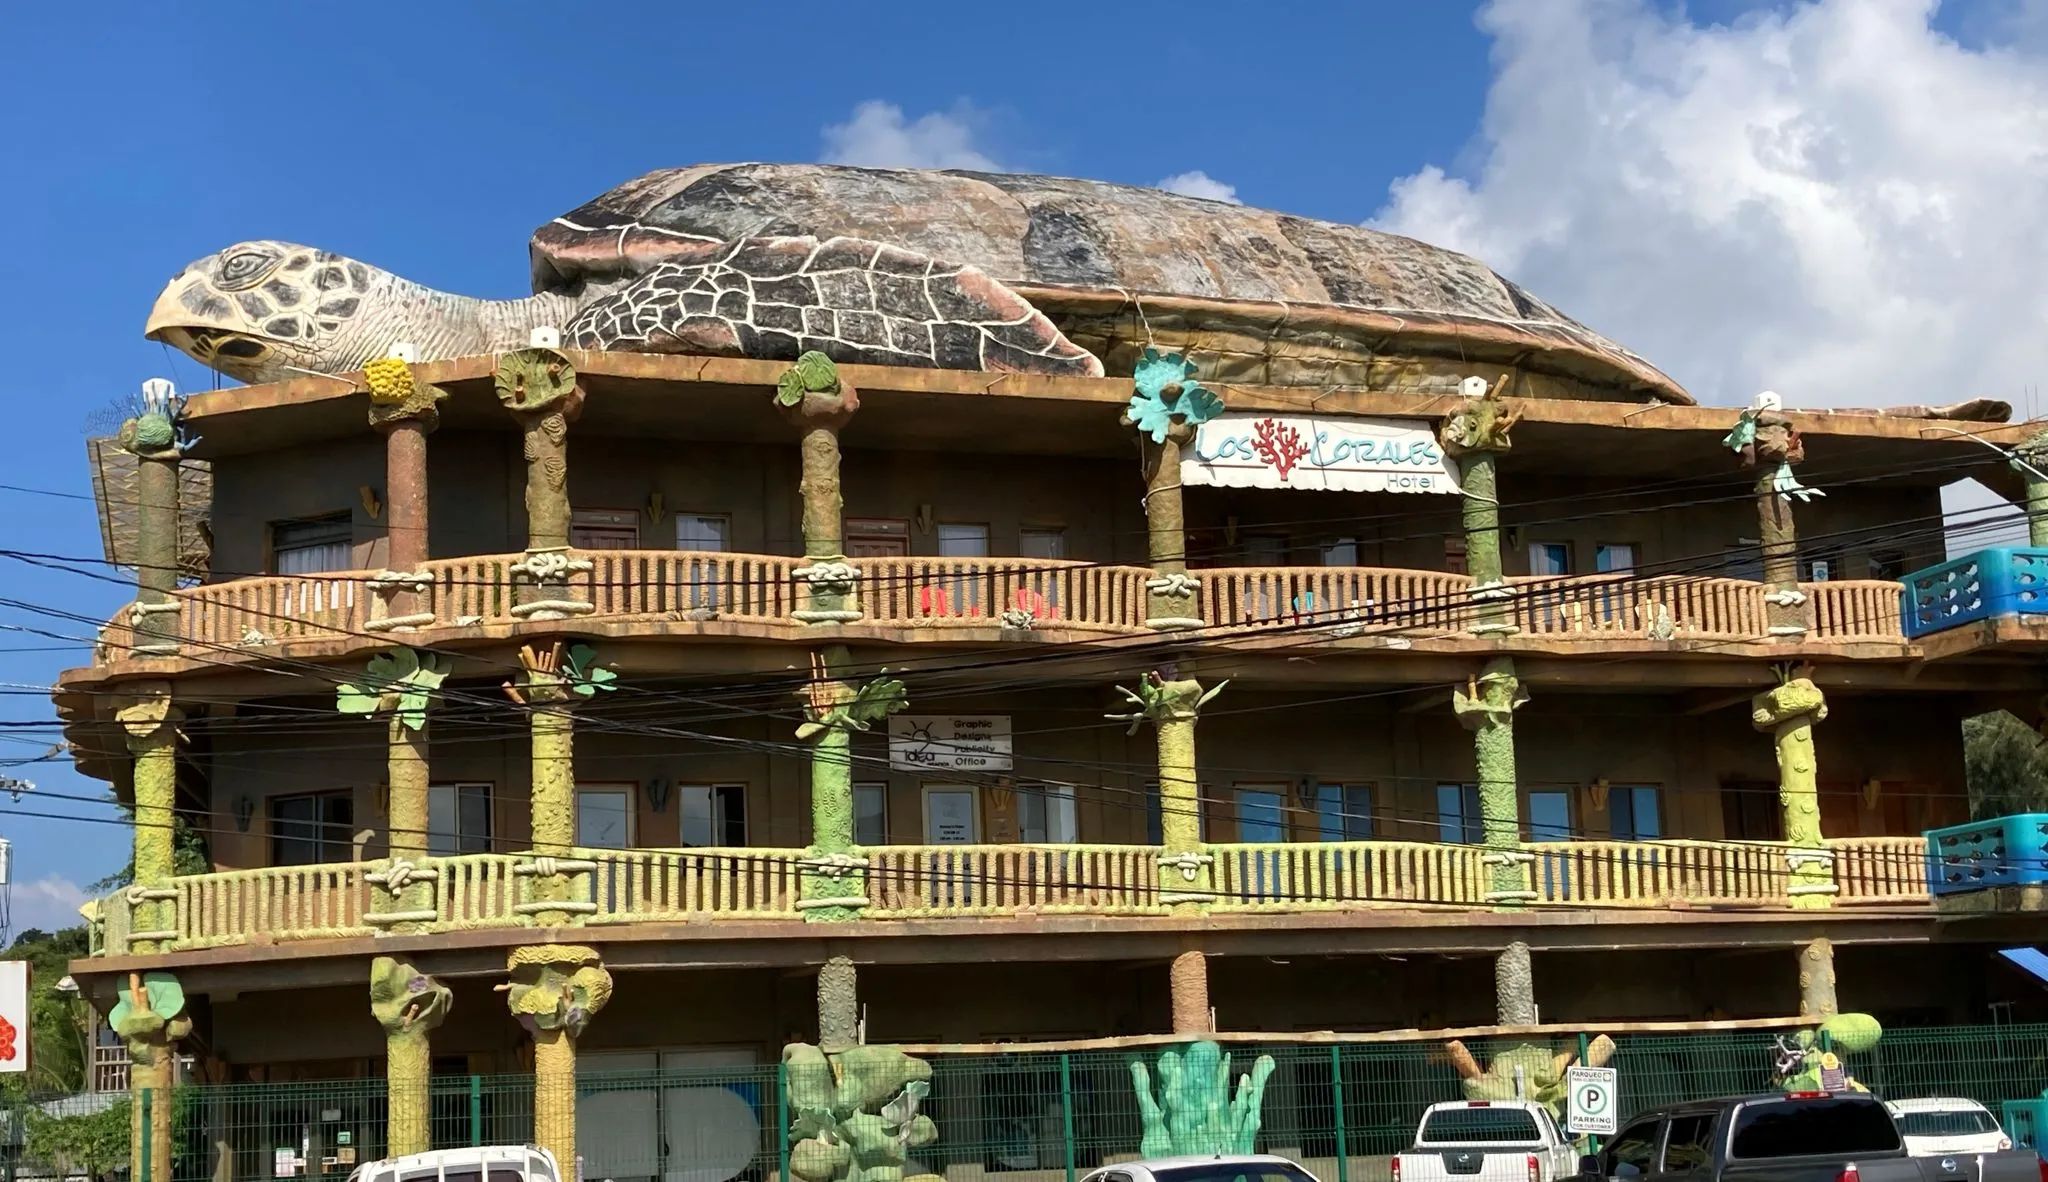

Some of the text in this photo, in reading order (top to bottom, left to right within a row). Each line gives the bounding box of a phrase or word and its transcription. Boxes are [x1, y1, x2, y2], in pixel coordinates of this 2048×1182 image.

[1195, 427, 1440, 467] LOS CORALES
[1387, 474, 1436, 489] Hotel
[953, 720, 993, 730] Graphic
[904, 748, 935, 763] idea
[954, 745, 995, 754] Publicity
[955, 757, 986, 766] Office
[1587, 1089, 1599, 1109] P
[1573, 1116, 1611, 1124] PARKING
